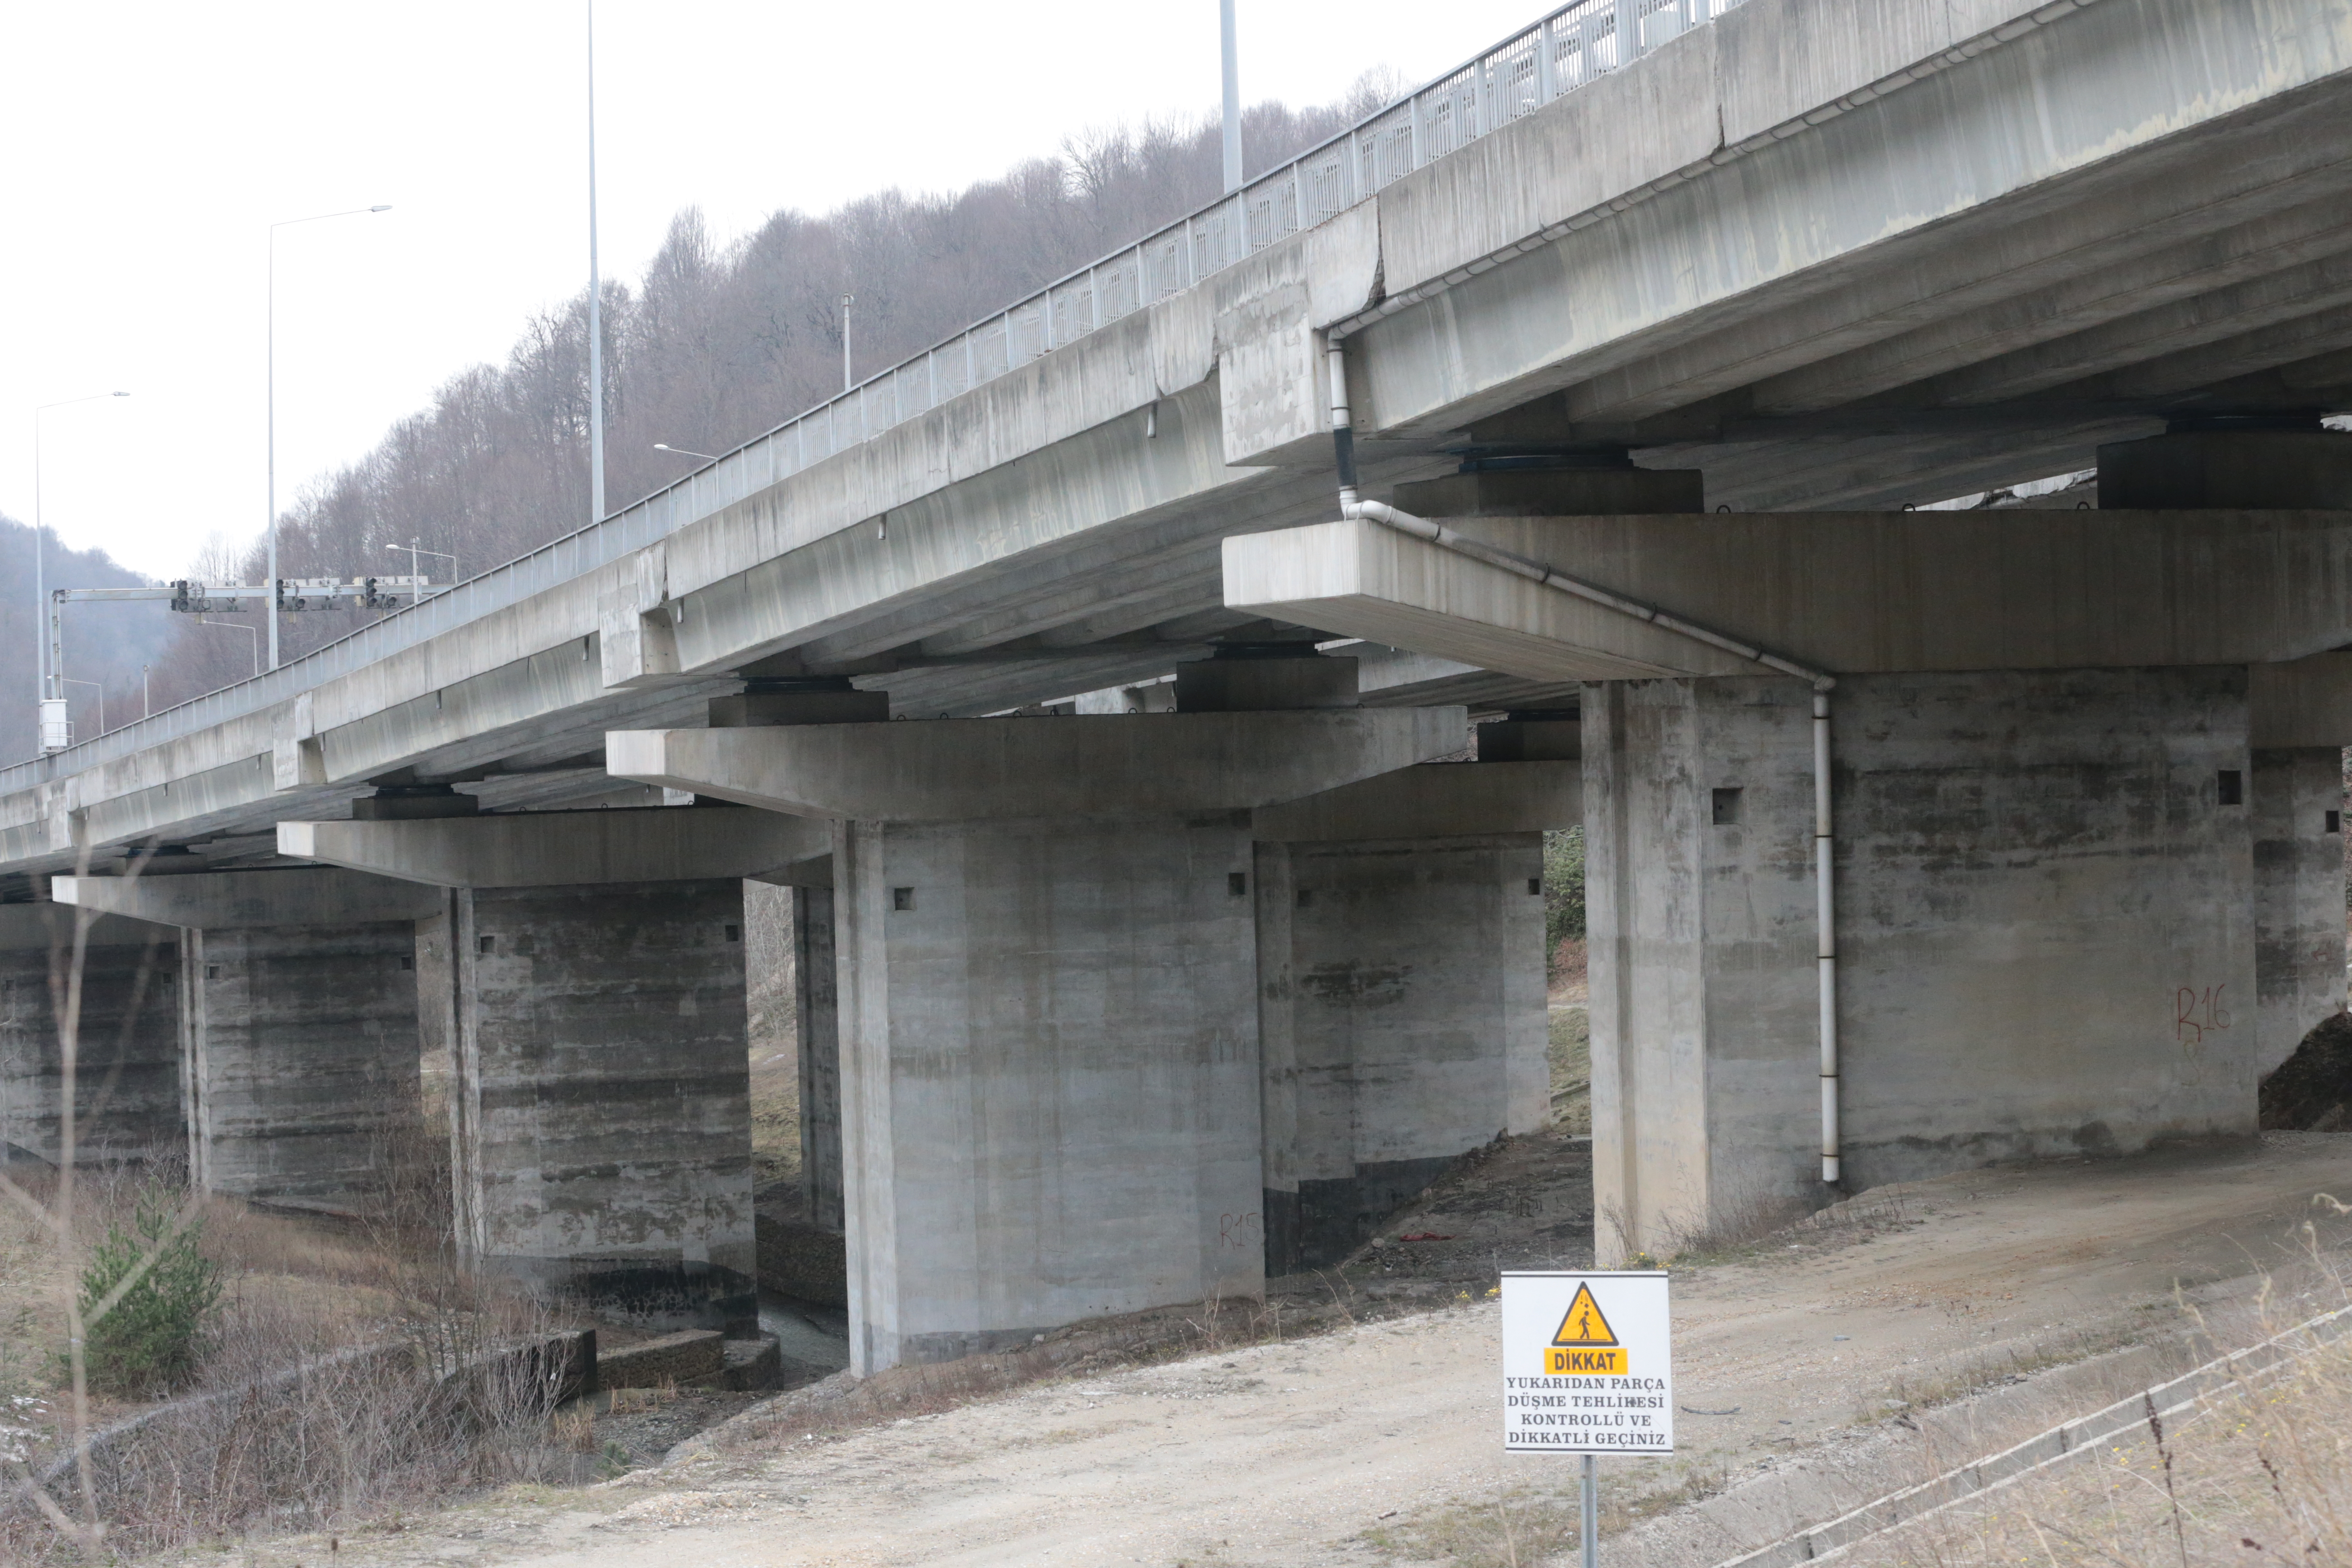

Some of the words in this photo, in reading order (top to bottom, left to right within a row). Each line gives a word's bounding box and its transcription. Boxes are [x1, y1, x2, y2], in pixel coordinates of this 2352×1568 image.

[2178, 983, 2230, 1043] R16
[1220, 1212, 1259, 1250] R15
[1554, 1348, 1616, 1370] DİKKAT
[1506, 1377, 1605, 1389] YUKARIDAN
[1611, 1378, 1665, 1392] PARÇA
[1508, 1392, 1566, 1410] DÜŞME
[1572, 1393, 1664, 1408] TEHLİKESİ
[1521, 1412, 1624, 1426] KONTROLLÜ
[1630, 1416, 1651, 1426] VE
[1509, 1429, 1589, 1444] DİKKATLİ
[1595, 1431, 1665, 1447] GEÇİNİZ
